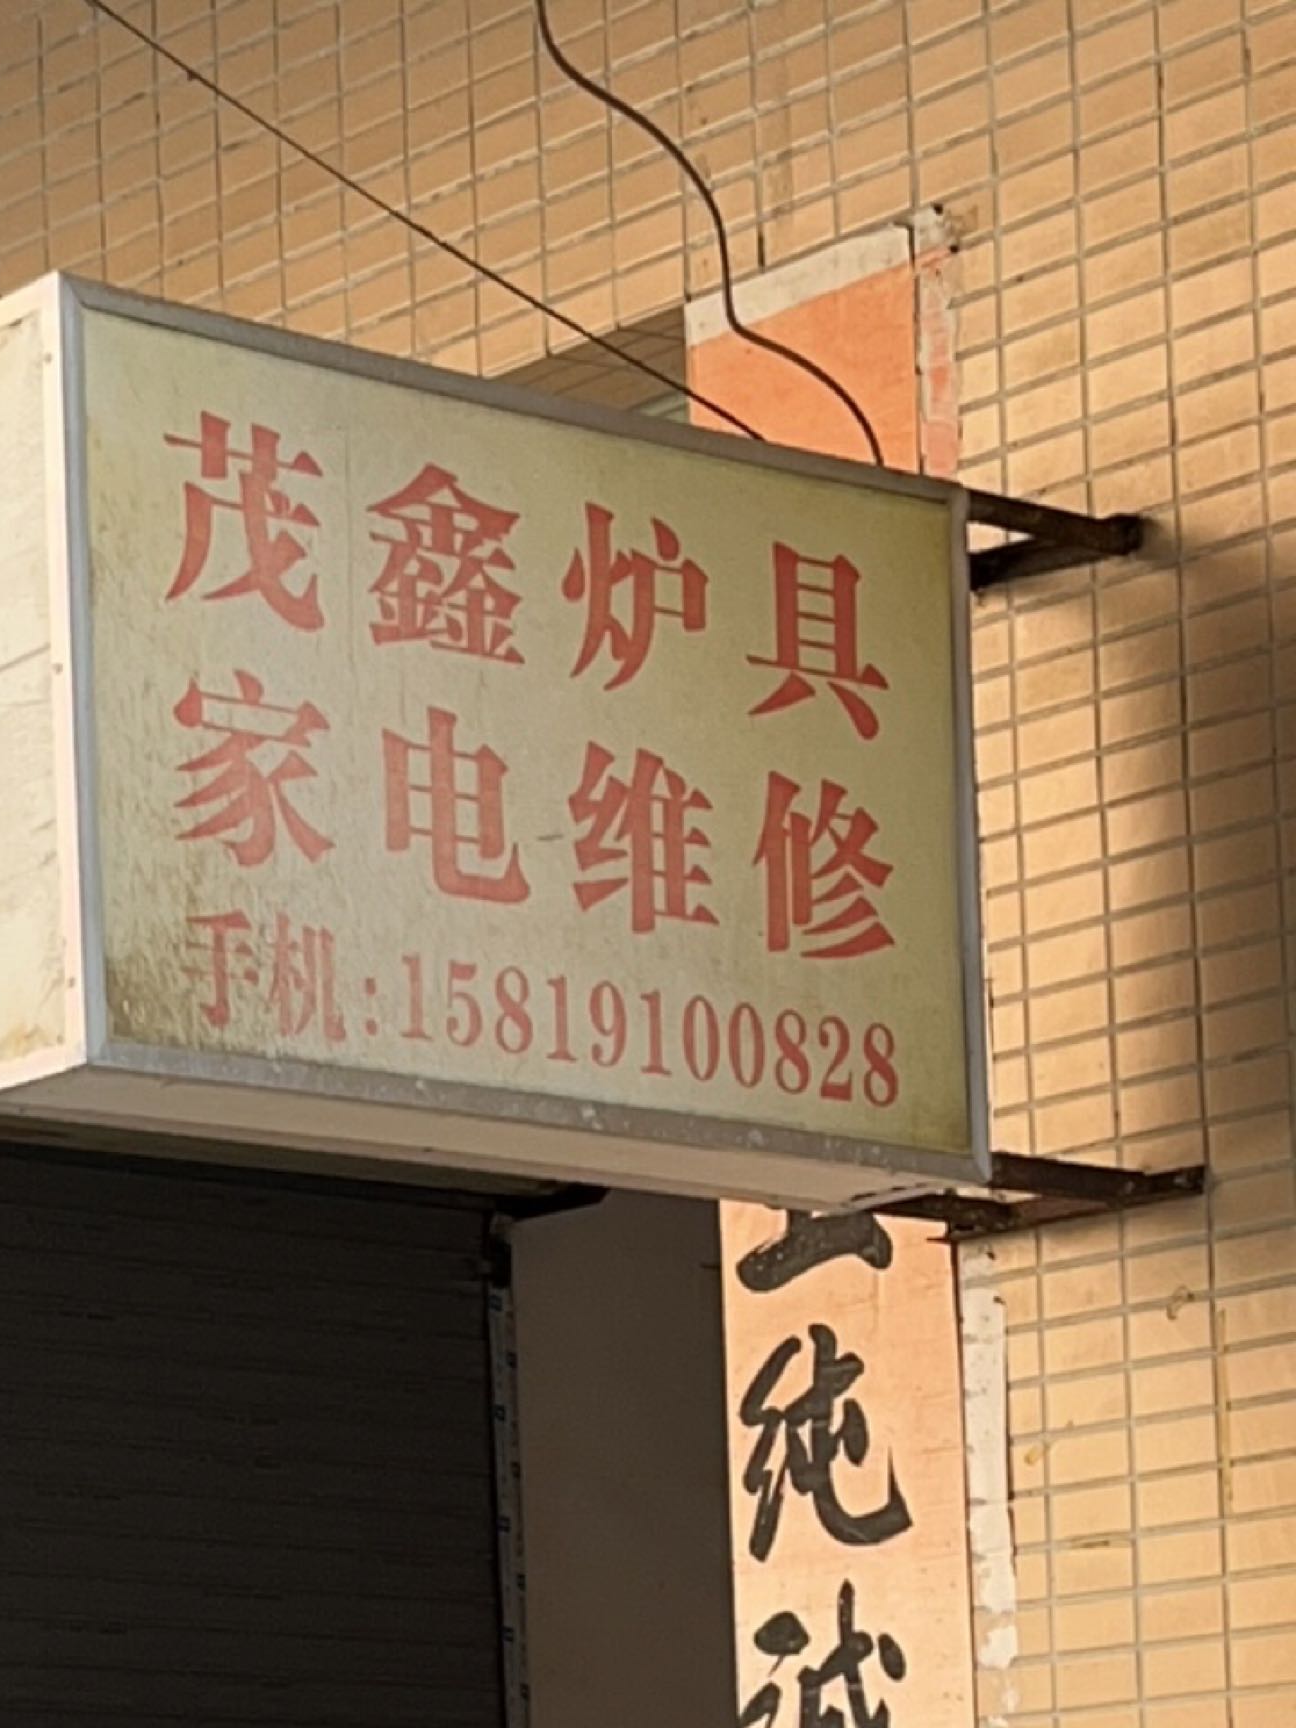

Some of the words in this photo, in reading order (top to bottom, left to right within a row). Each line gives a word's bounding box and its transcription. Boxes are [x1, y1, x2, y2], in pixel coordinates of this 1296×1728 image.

[163, 410, 889, 741] 茂鑫炉具
[173, 668, 897, 962] 家电维修
